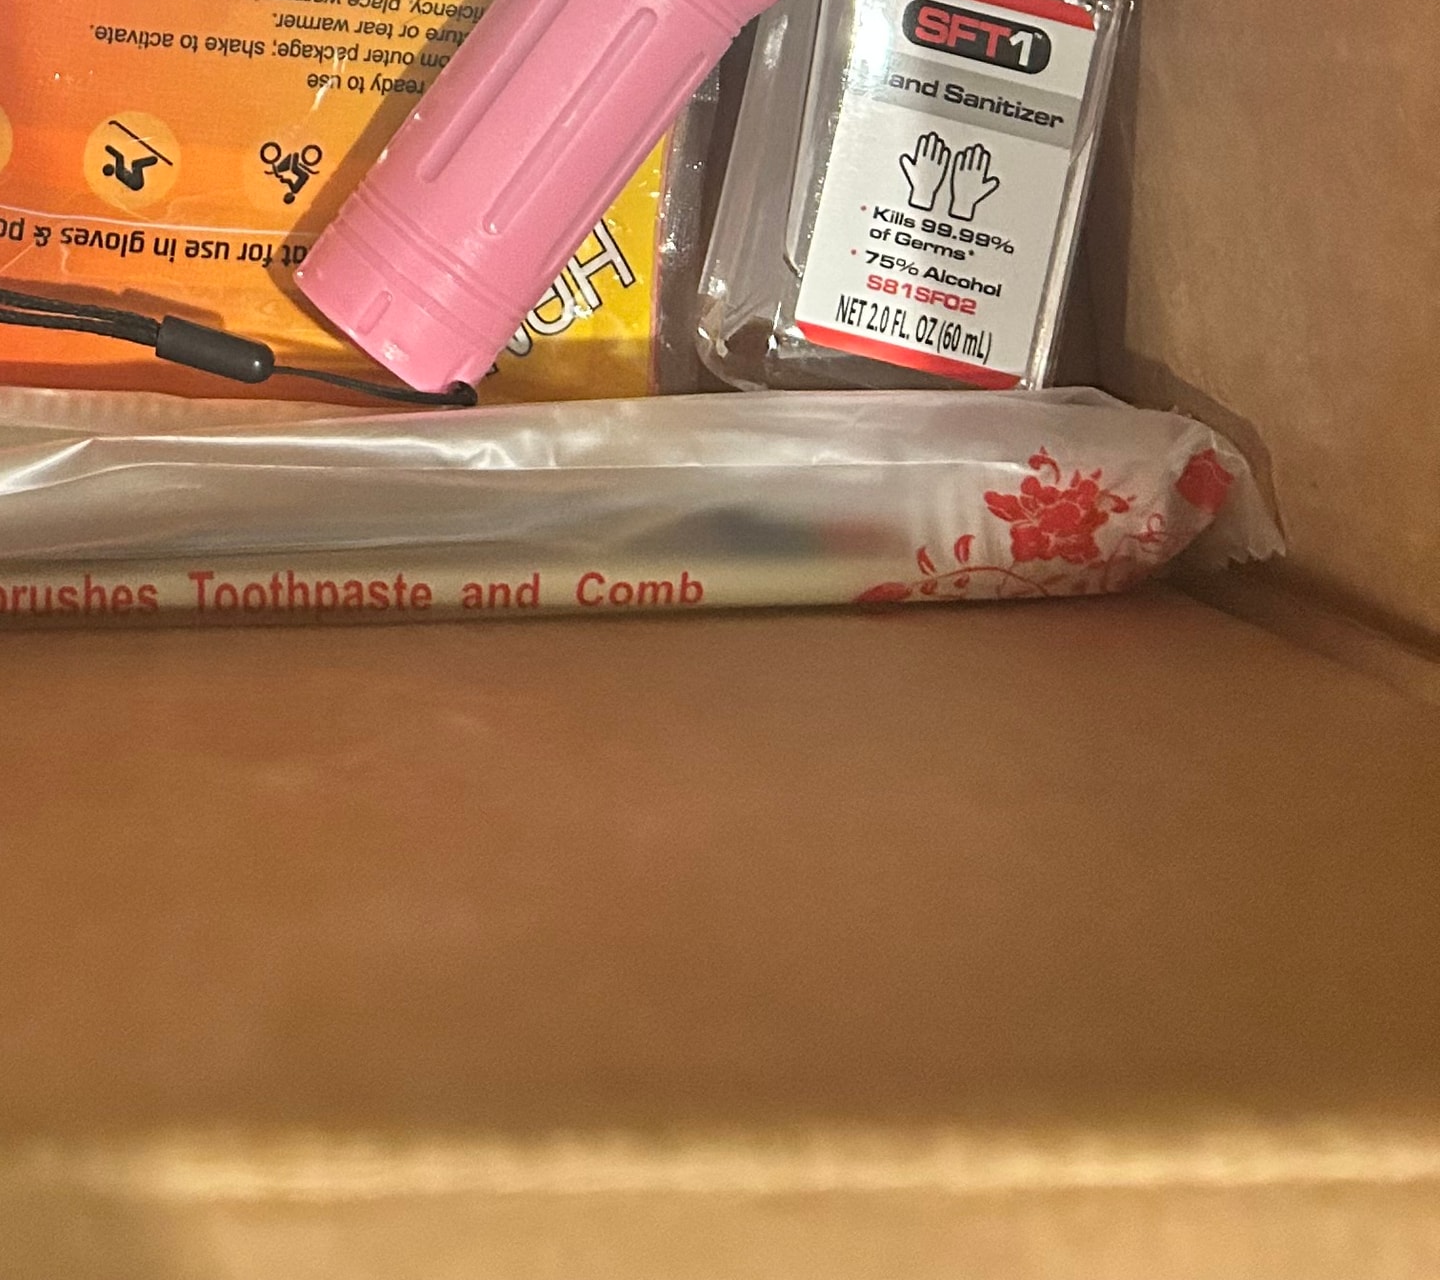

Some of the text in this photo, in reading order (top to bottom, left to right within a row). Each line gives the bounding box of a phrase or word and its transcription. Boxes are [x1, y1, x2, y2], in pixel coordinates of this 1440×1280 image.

[89, 23, 175, 49] activate.
[272, 12, 420, 40] or tear warmer.
[179, 33, 199, 53] to
[204, 35, 266, 58] shake
[363, 47, 414, 68] outer
[306, 72, 427, 95] ready to use
[885, 71, 1065, 131] and Sanitizer
[34, 225, 53, 247] &
[60, 227, 146, 257] gloves
[868, 226, 893, 243] of
[872, 205, 1016, 255] Kills 99.99%
[153, 236, 177, 264] in
[185, 238, 231, 261] use
[235, 239, 275, 268] for
[864, 250, 1003, 298] 75% Alcohol
[835, 293, 869, 326] NET
[868, 302, 890, 325] 2.0
[915, 314, 939, 347] OZ
[937, 320, 963, 355] (60
[962, 327, 995, 365] mL)
[189, 570, 433, 622] Toothpaste
[460, 573, 541, 613] and
[576, 571, 705, 609] Comb
